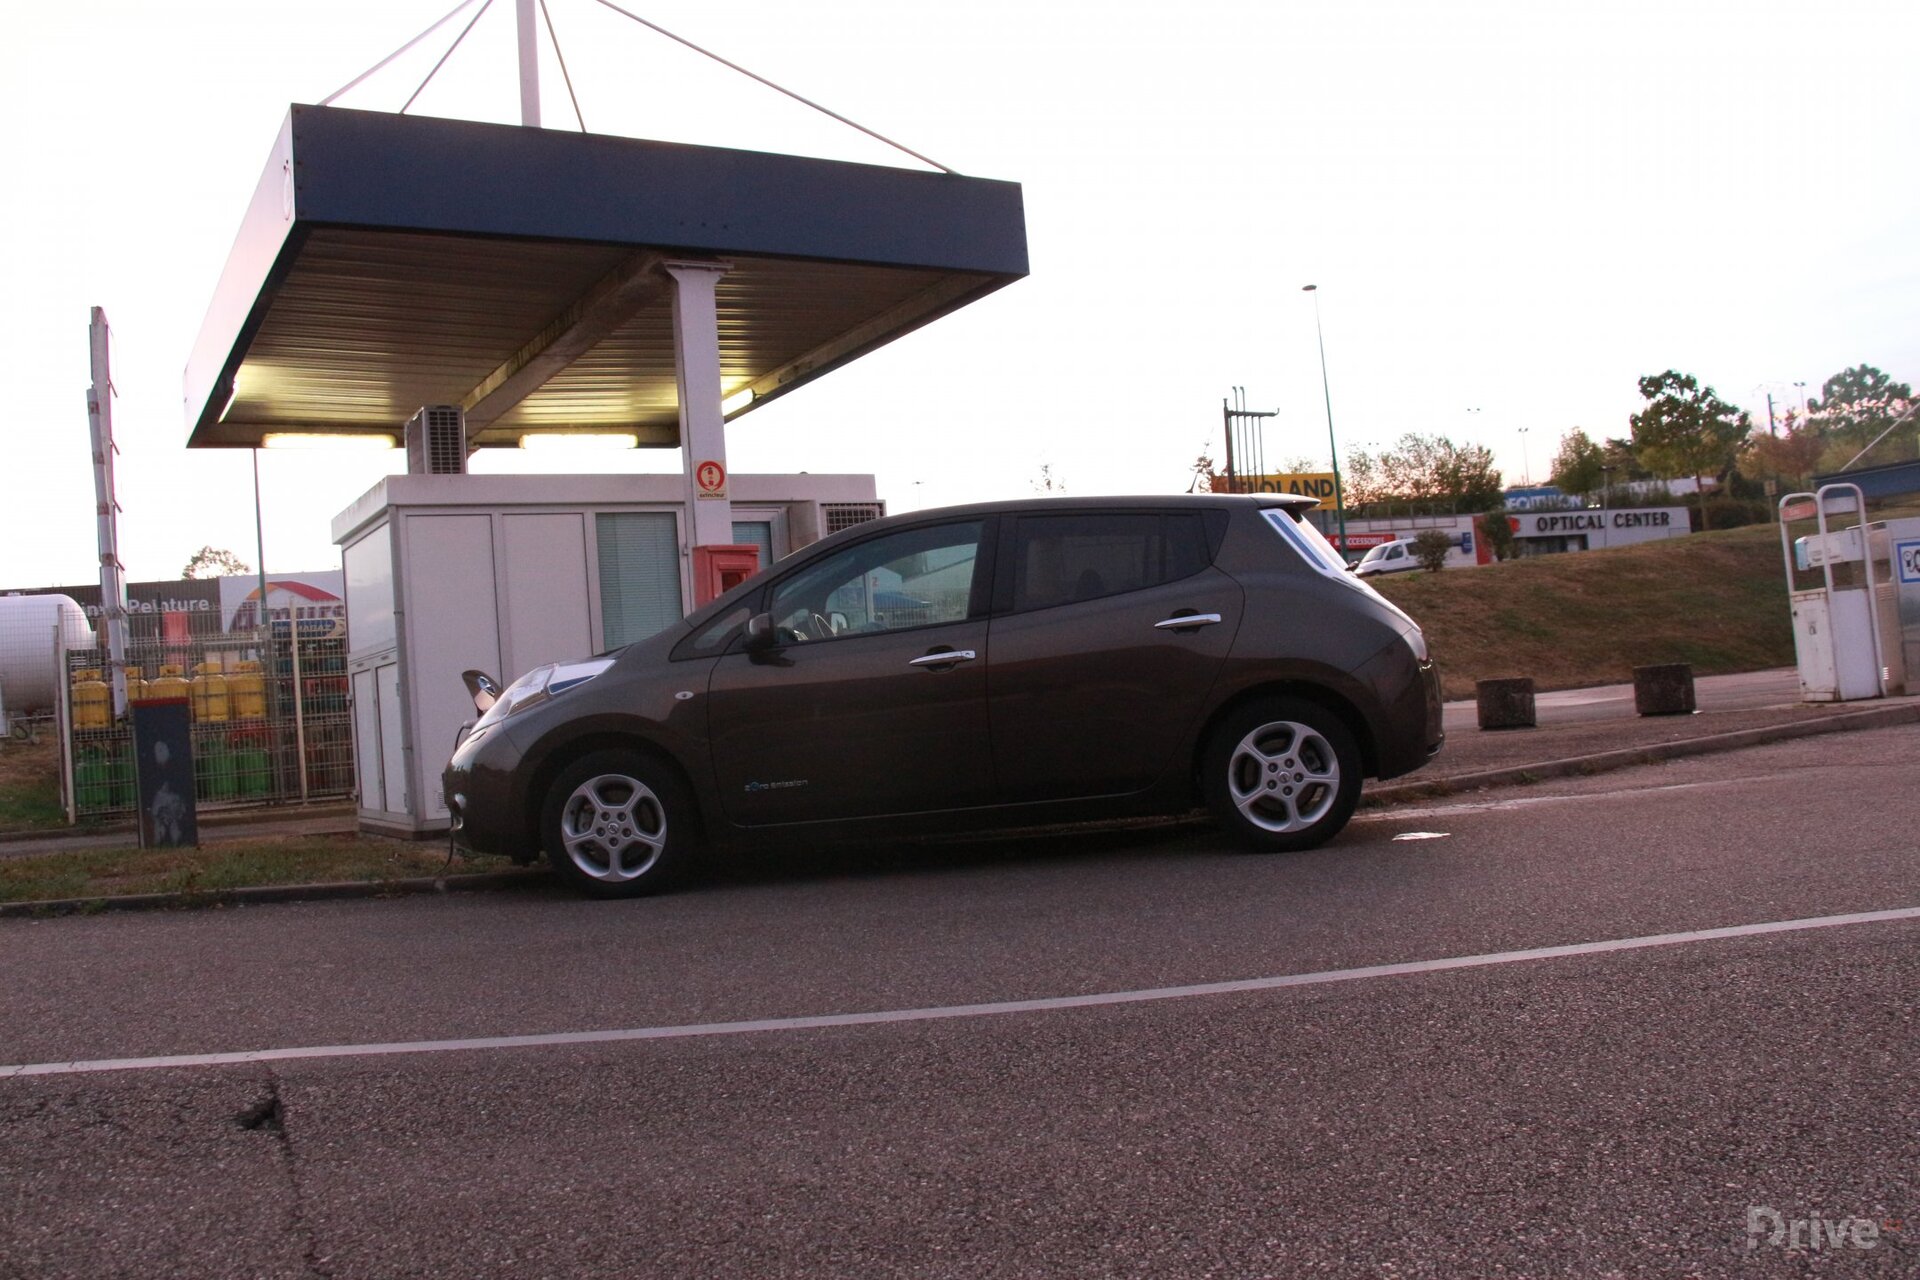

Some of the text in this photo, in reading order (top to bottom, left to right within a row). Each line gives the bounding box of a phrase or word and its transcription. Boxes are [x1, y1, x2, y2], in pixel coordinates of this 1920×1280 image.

[1537, 512, 1670, 532] OPTICAL CENTER
[128, 598, 209, 614] Peinture
